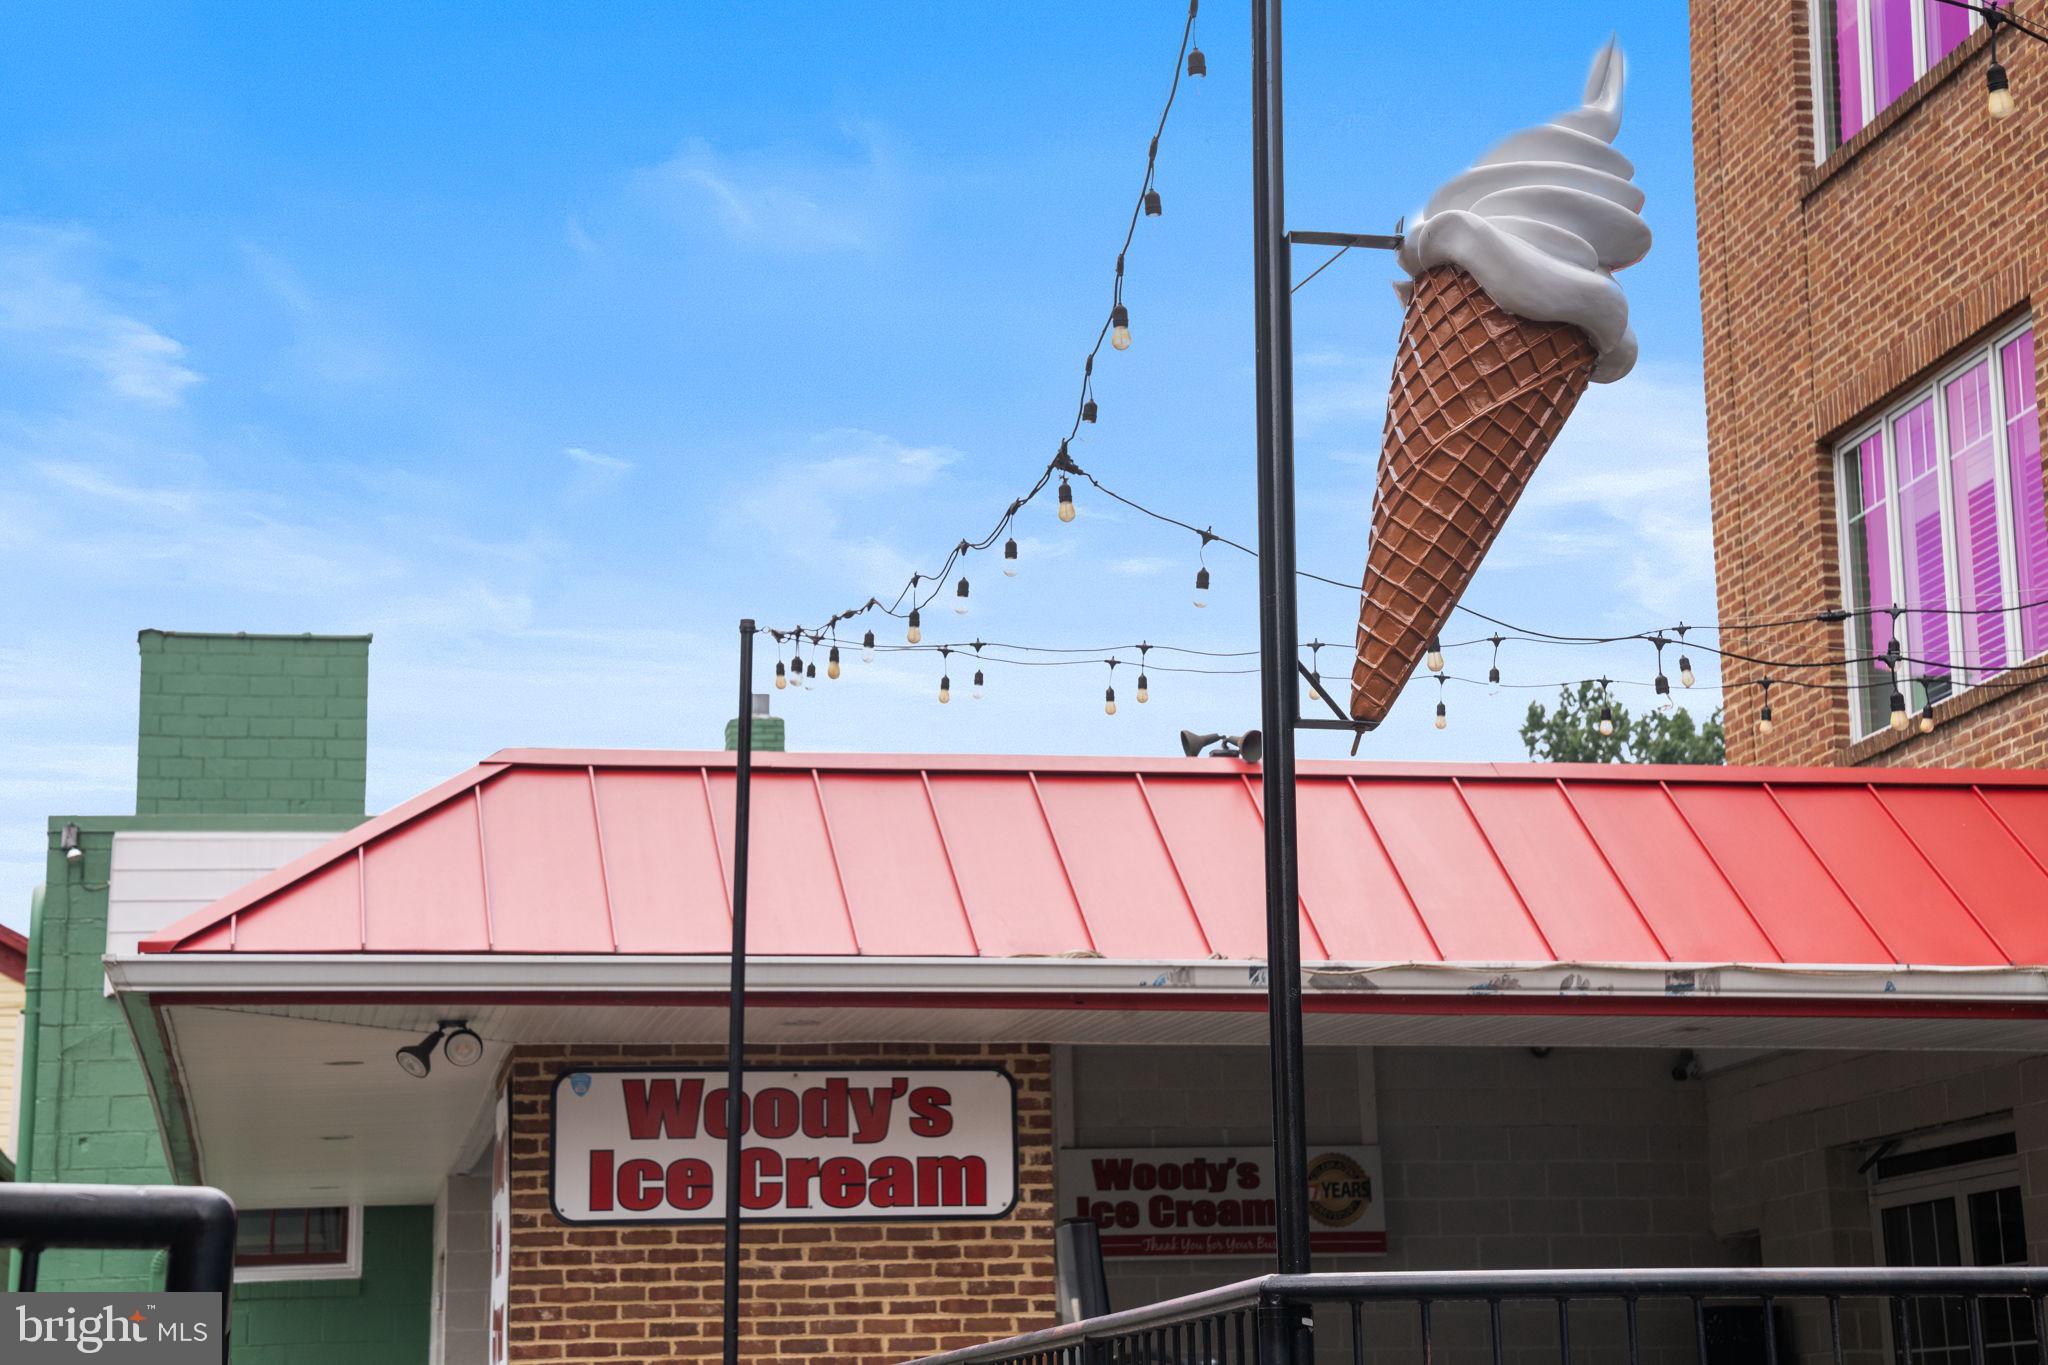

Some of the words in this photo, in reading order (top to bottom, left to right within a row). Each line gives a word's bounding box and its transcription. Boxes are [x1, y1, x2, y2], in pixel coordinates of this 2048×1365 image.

[622, 1078, 953, 1144] Woody's
[589, 1149, 713, 1211] Ice
[739, 1146, 988, 1210] Cream
[1092, 1158, 1260, 1193] Woody's
[1321, 1182, 1370, 1199] YEARS
[1076, 1196, 1140, 1229] Ice
[1148, 1195, 1276, 1228] Cream
[1142, 1236, 1178, 1253] Thank
[1181, 1237, 1202, 1251] You
[1205, 1235, 1223, 1253] for
[1226, 1237, 1252, 1253] Your
